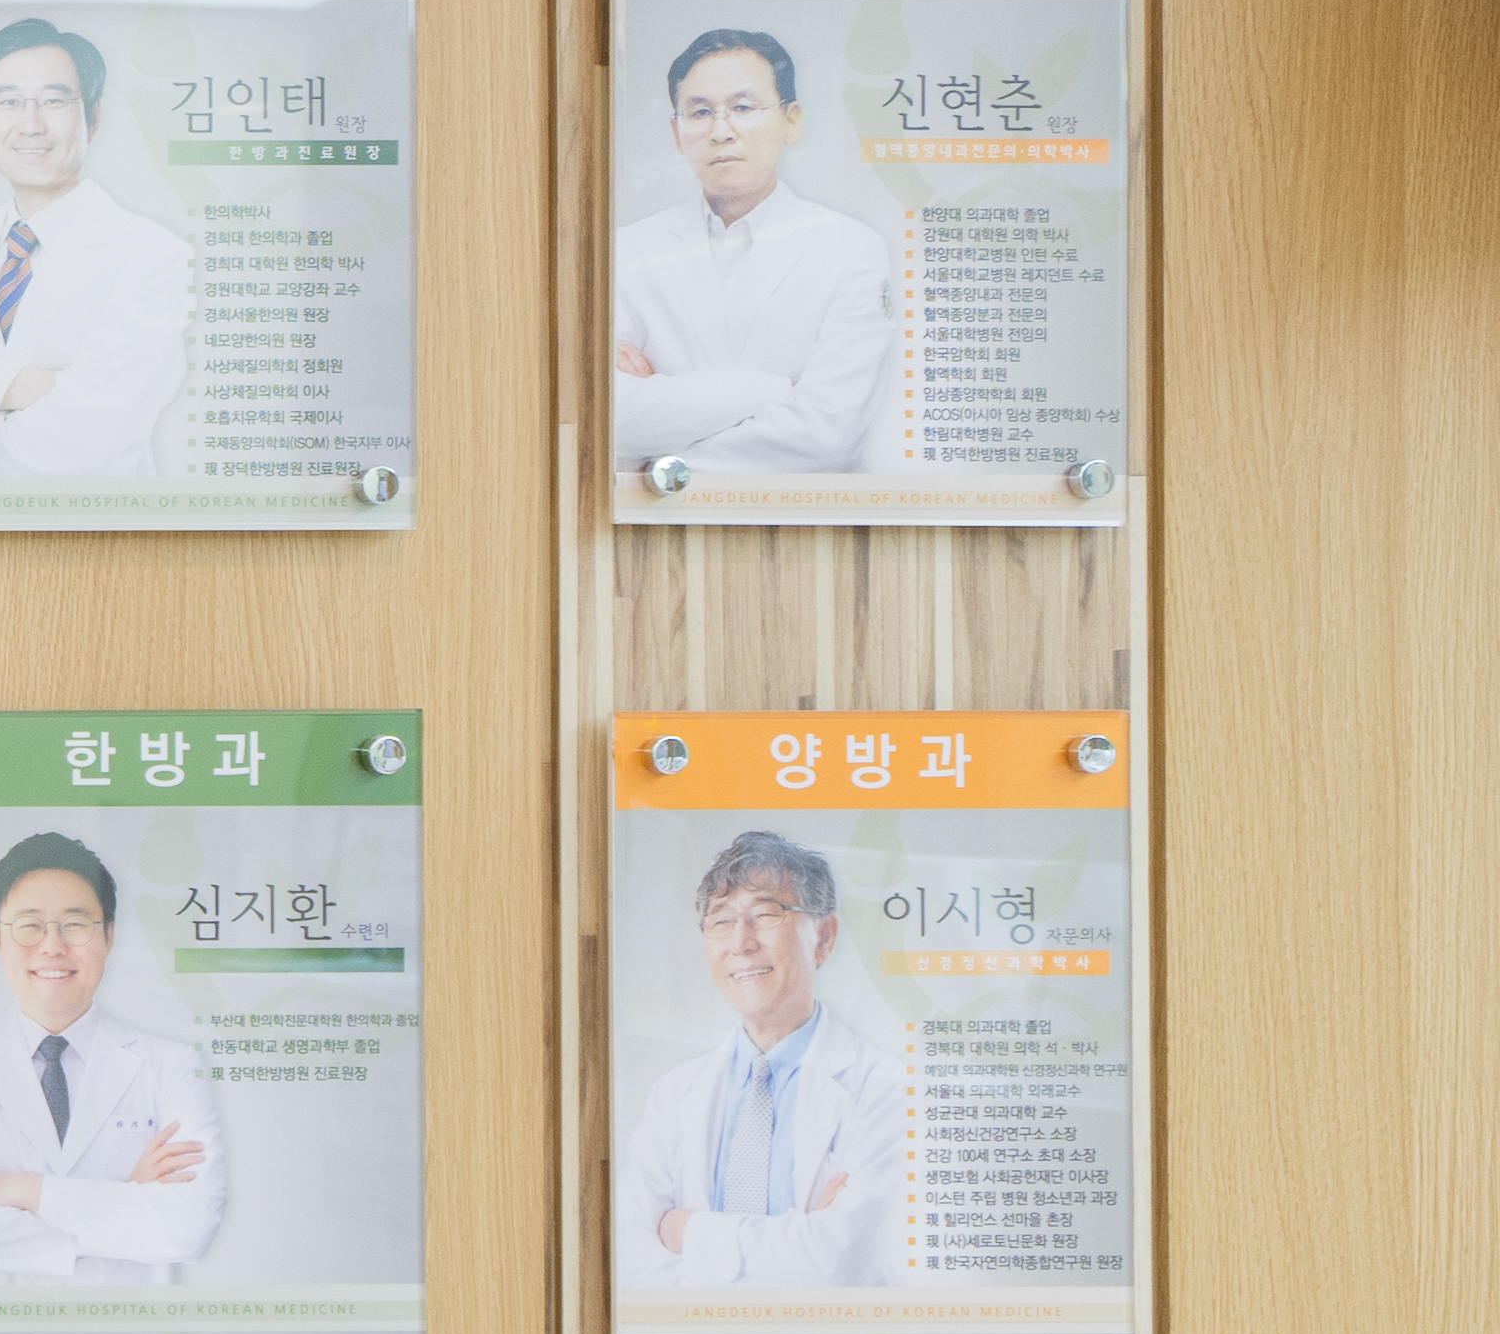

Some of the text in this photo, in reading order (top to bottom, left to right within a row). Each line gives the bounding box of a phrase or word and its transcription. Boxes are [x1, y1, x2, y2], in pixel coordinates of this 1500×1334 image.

[171, 75, 368, 134] 김인태 원장
[882, 73, 1079, 134] 신현춘 원장
[229, 145, 381, 161] 한방과진료원장
[63, 730, 266, 788] 한방과
[769, 732, 972, 790] 양방과
[175, 883, 389, 942] 심지환 수련의
[882, 886, 1113, 945] 이시형 자문의사
[917, 956, 1091, 970] 신경정신과학박사
[924, 1126, 1078, 1143] 사회정신건강연구소 소장
